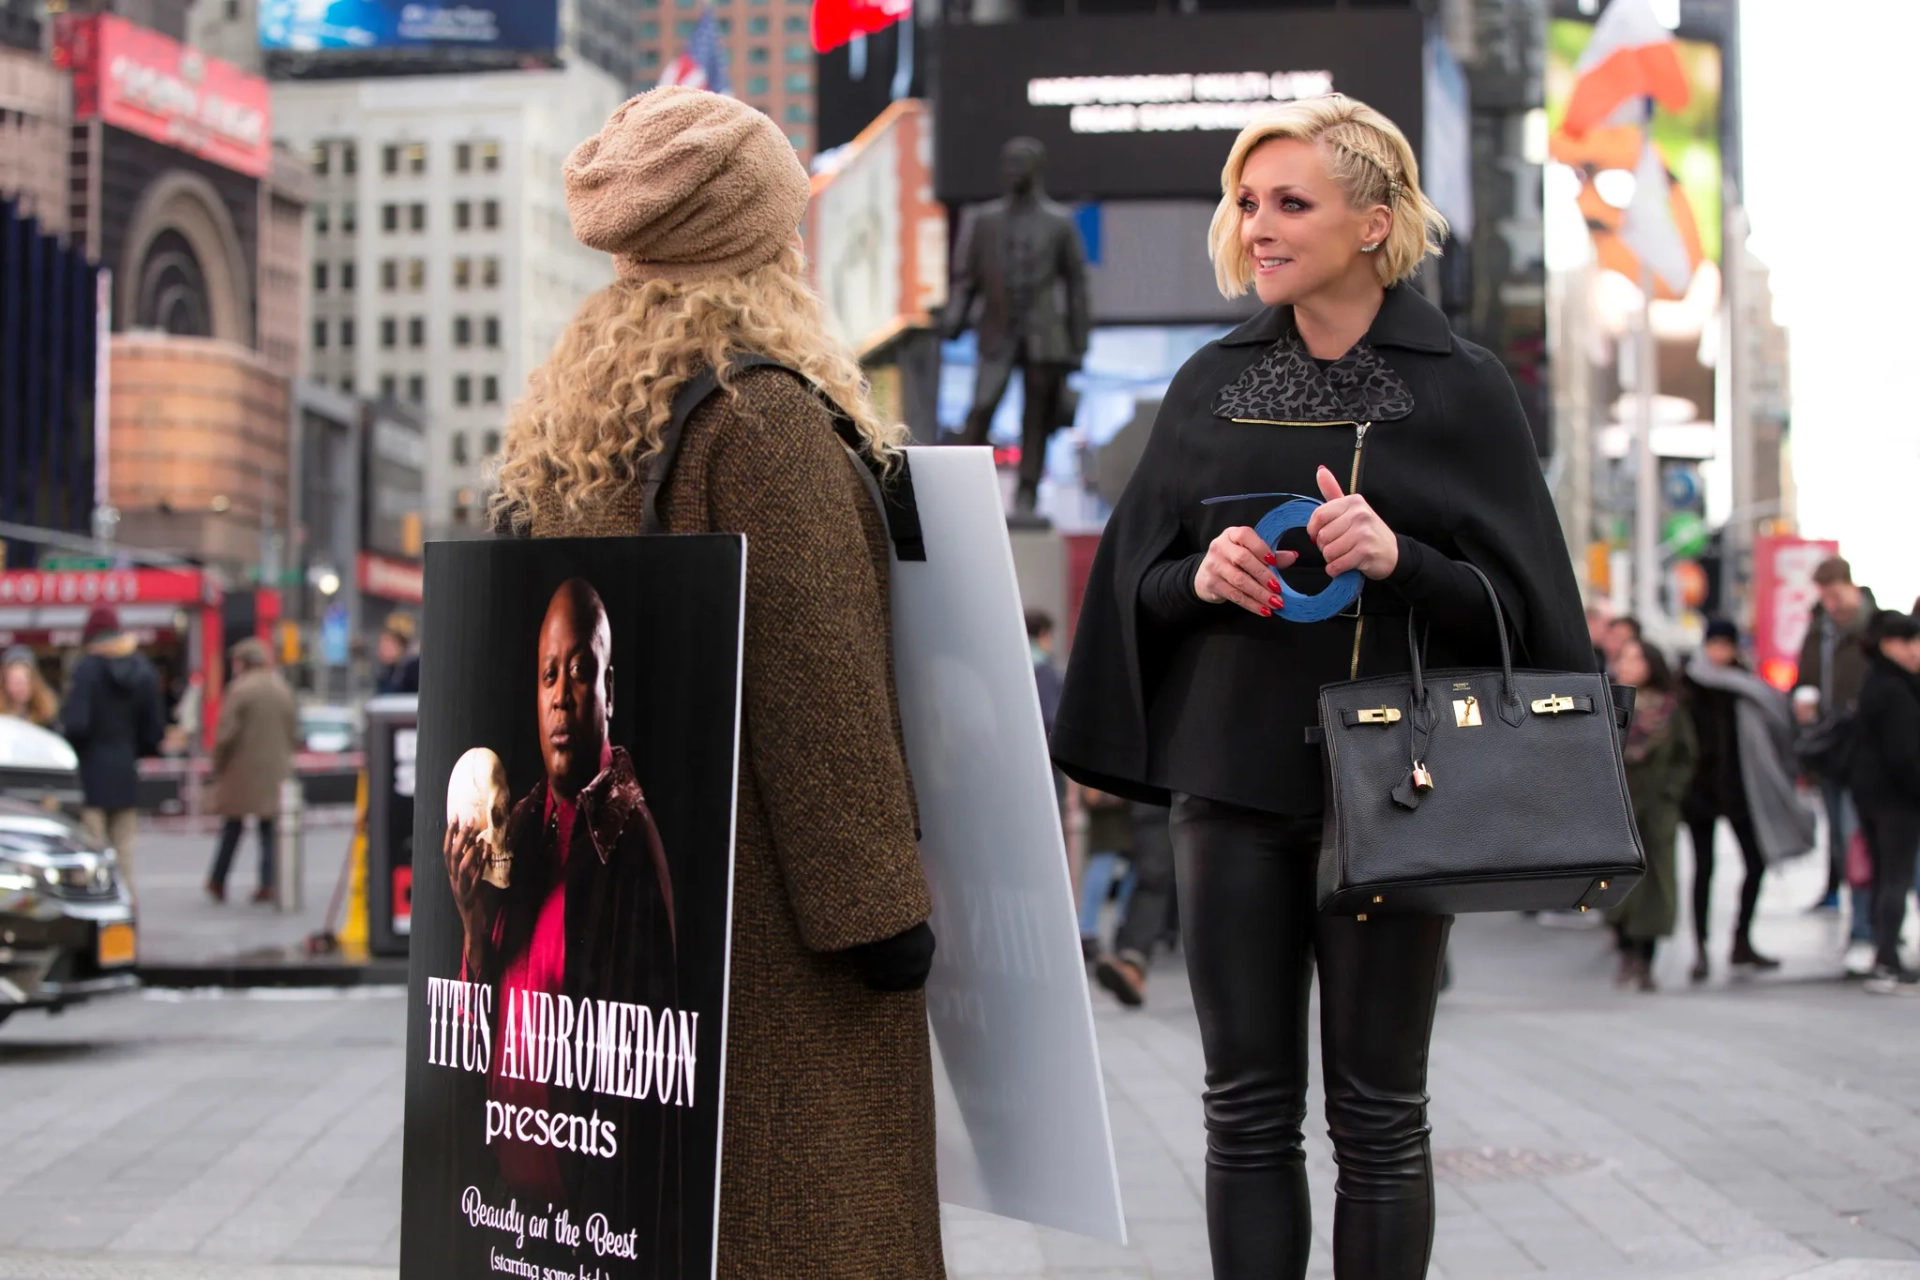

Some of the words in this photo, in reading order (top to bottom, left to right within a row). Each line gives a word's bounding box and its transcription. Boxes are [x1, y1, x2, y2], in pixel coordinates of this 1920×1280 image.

[427, 976, 492, 1075] TITUS
[500, 986, 700, 1108] ANDROMEDON
[485, 1099, 618, 1159] presents
[461, 1185, 525, 1250] Beaudy
[554, 1208, 581, 1248] the
[585, 1212, 638, 1260] Beest
[490, 1245, 540, 1280] (starring
